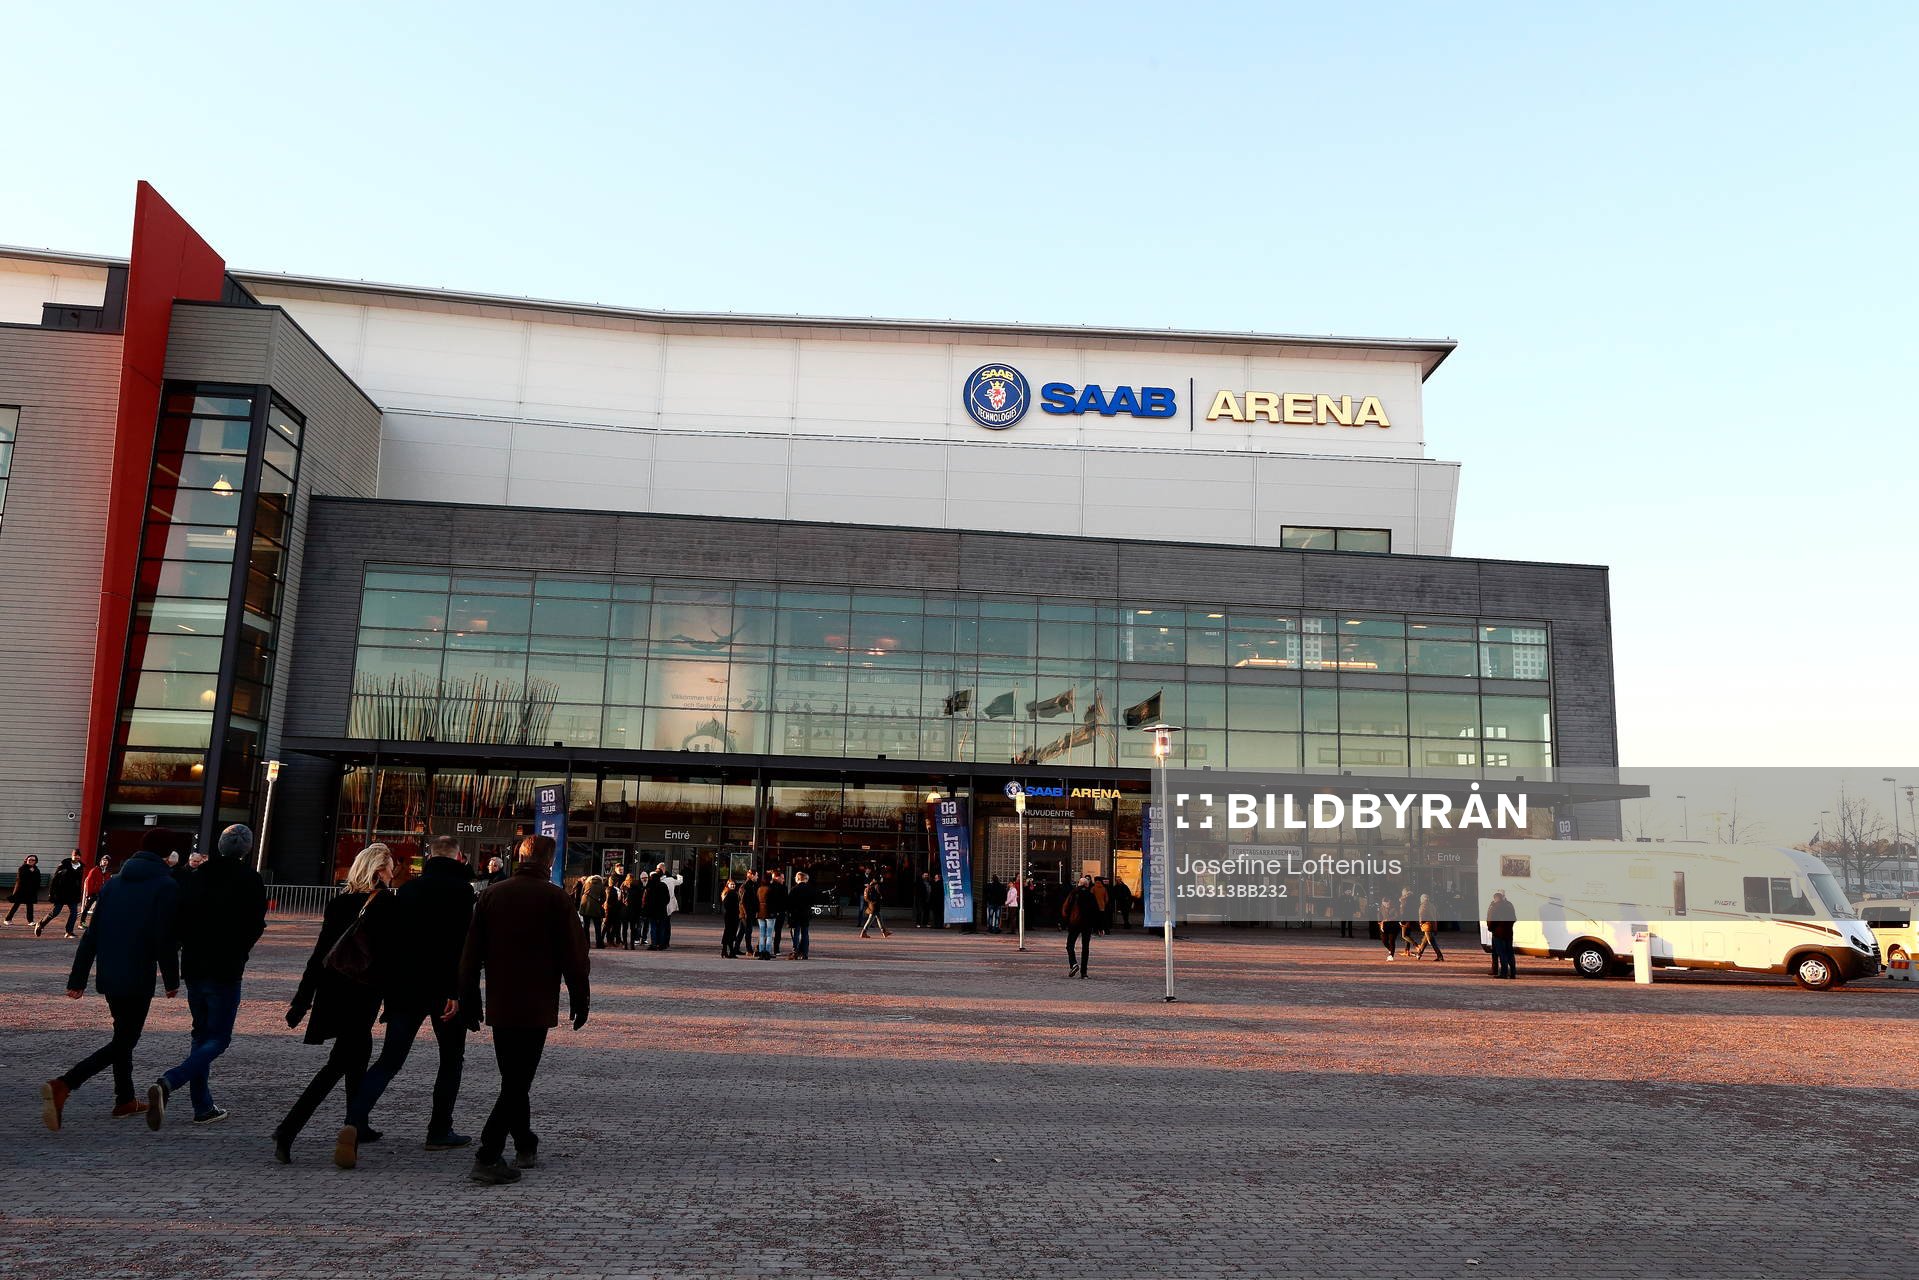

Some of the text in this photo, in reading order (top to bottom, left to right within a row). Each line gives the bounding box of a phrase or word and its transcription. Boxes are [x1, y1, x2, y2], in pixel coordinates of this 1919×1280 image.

[981, 369, 1014, 381] SAAB
[1041, 382, 1391, 427] SAAB ARENA
[977, 407, 1017, 422] TECHNOLOGIES
[1025, 785, 1122, 799] SAAB ARENA
[1024, 809, 1075, 817] HUVUDENTRÉ
[456, 822, 483, 833] Entré
[842, 817, 890, 829] SLUTSPEL
[664, 829, 691, 840] Entré
[1437, 852, 1461, 862] Entré
